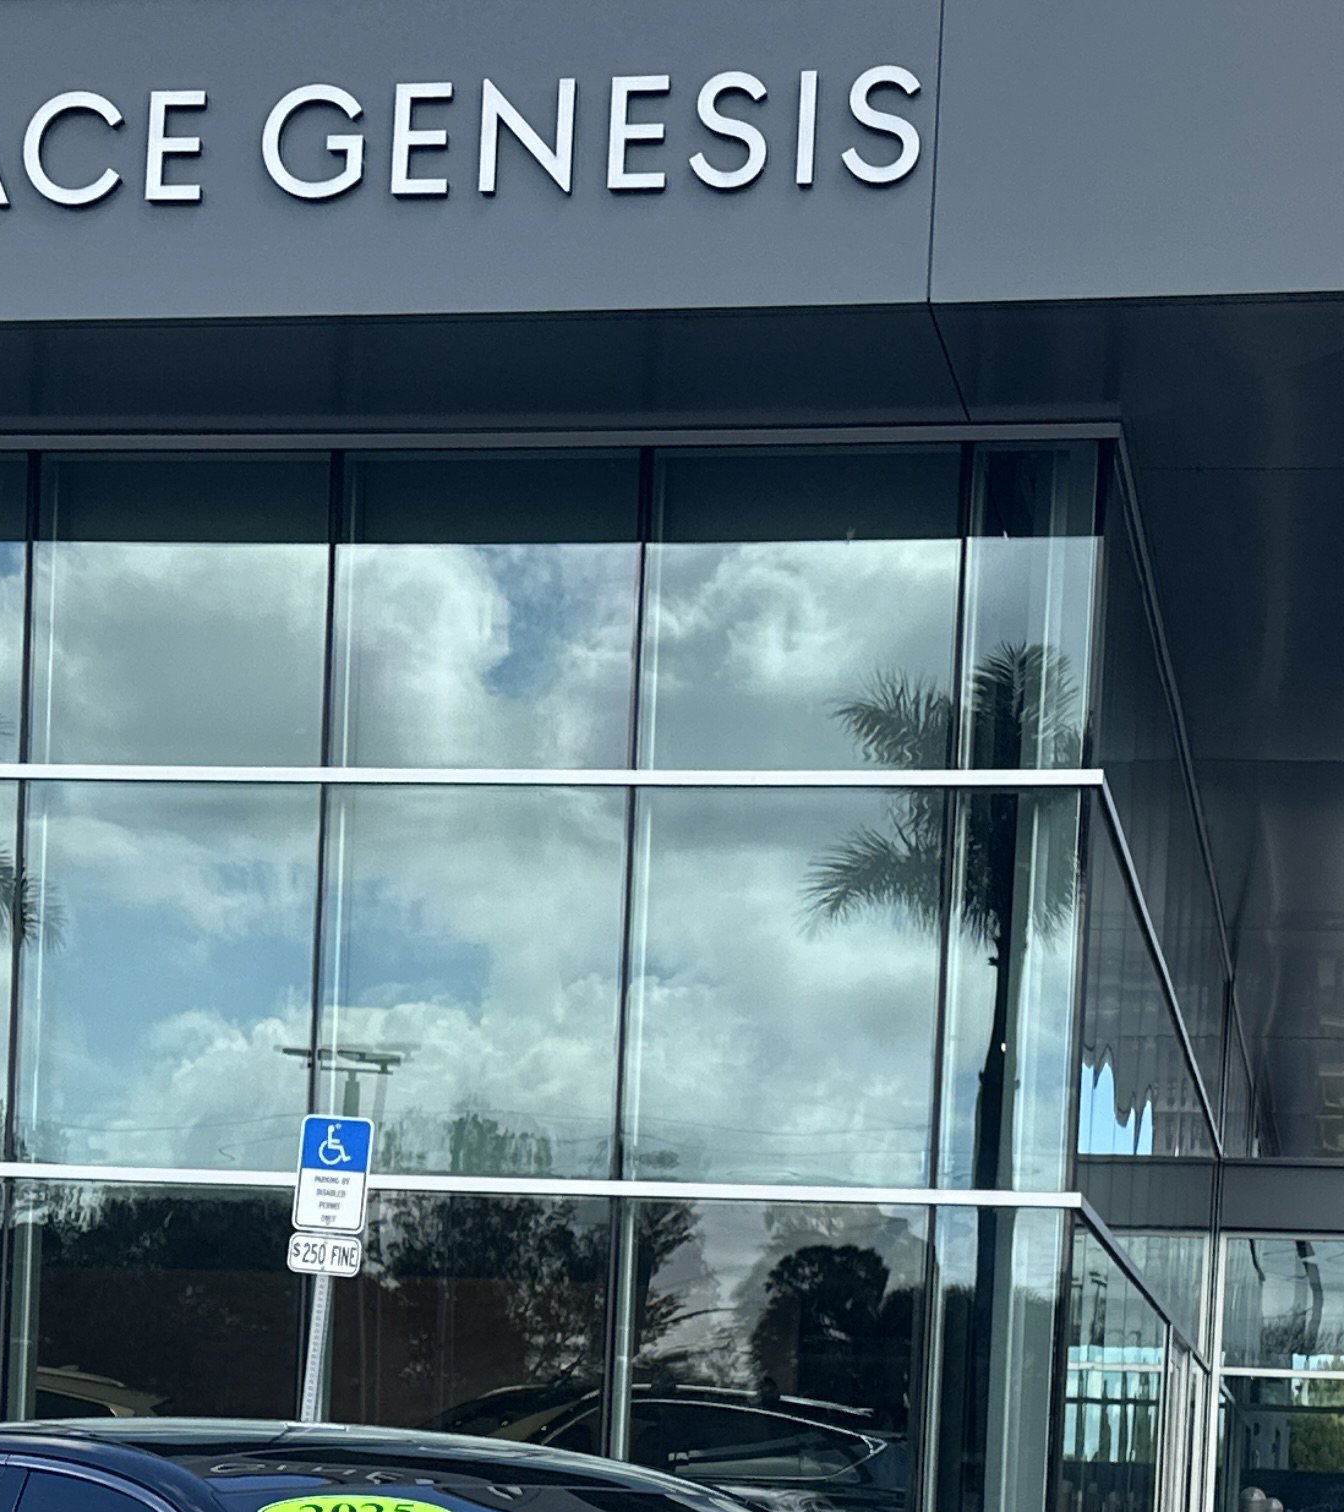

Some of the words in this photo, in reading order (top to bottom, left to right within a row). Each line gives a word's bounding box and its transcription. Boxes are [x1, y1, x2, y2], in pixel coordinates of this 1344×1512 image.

[261, 64, 922, 199] GENESIS
[292, 1242, 326, 1265] $250
[330, 1245, 357, 1267] FINE
